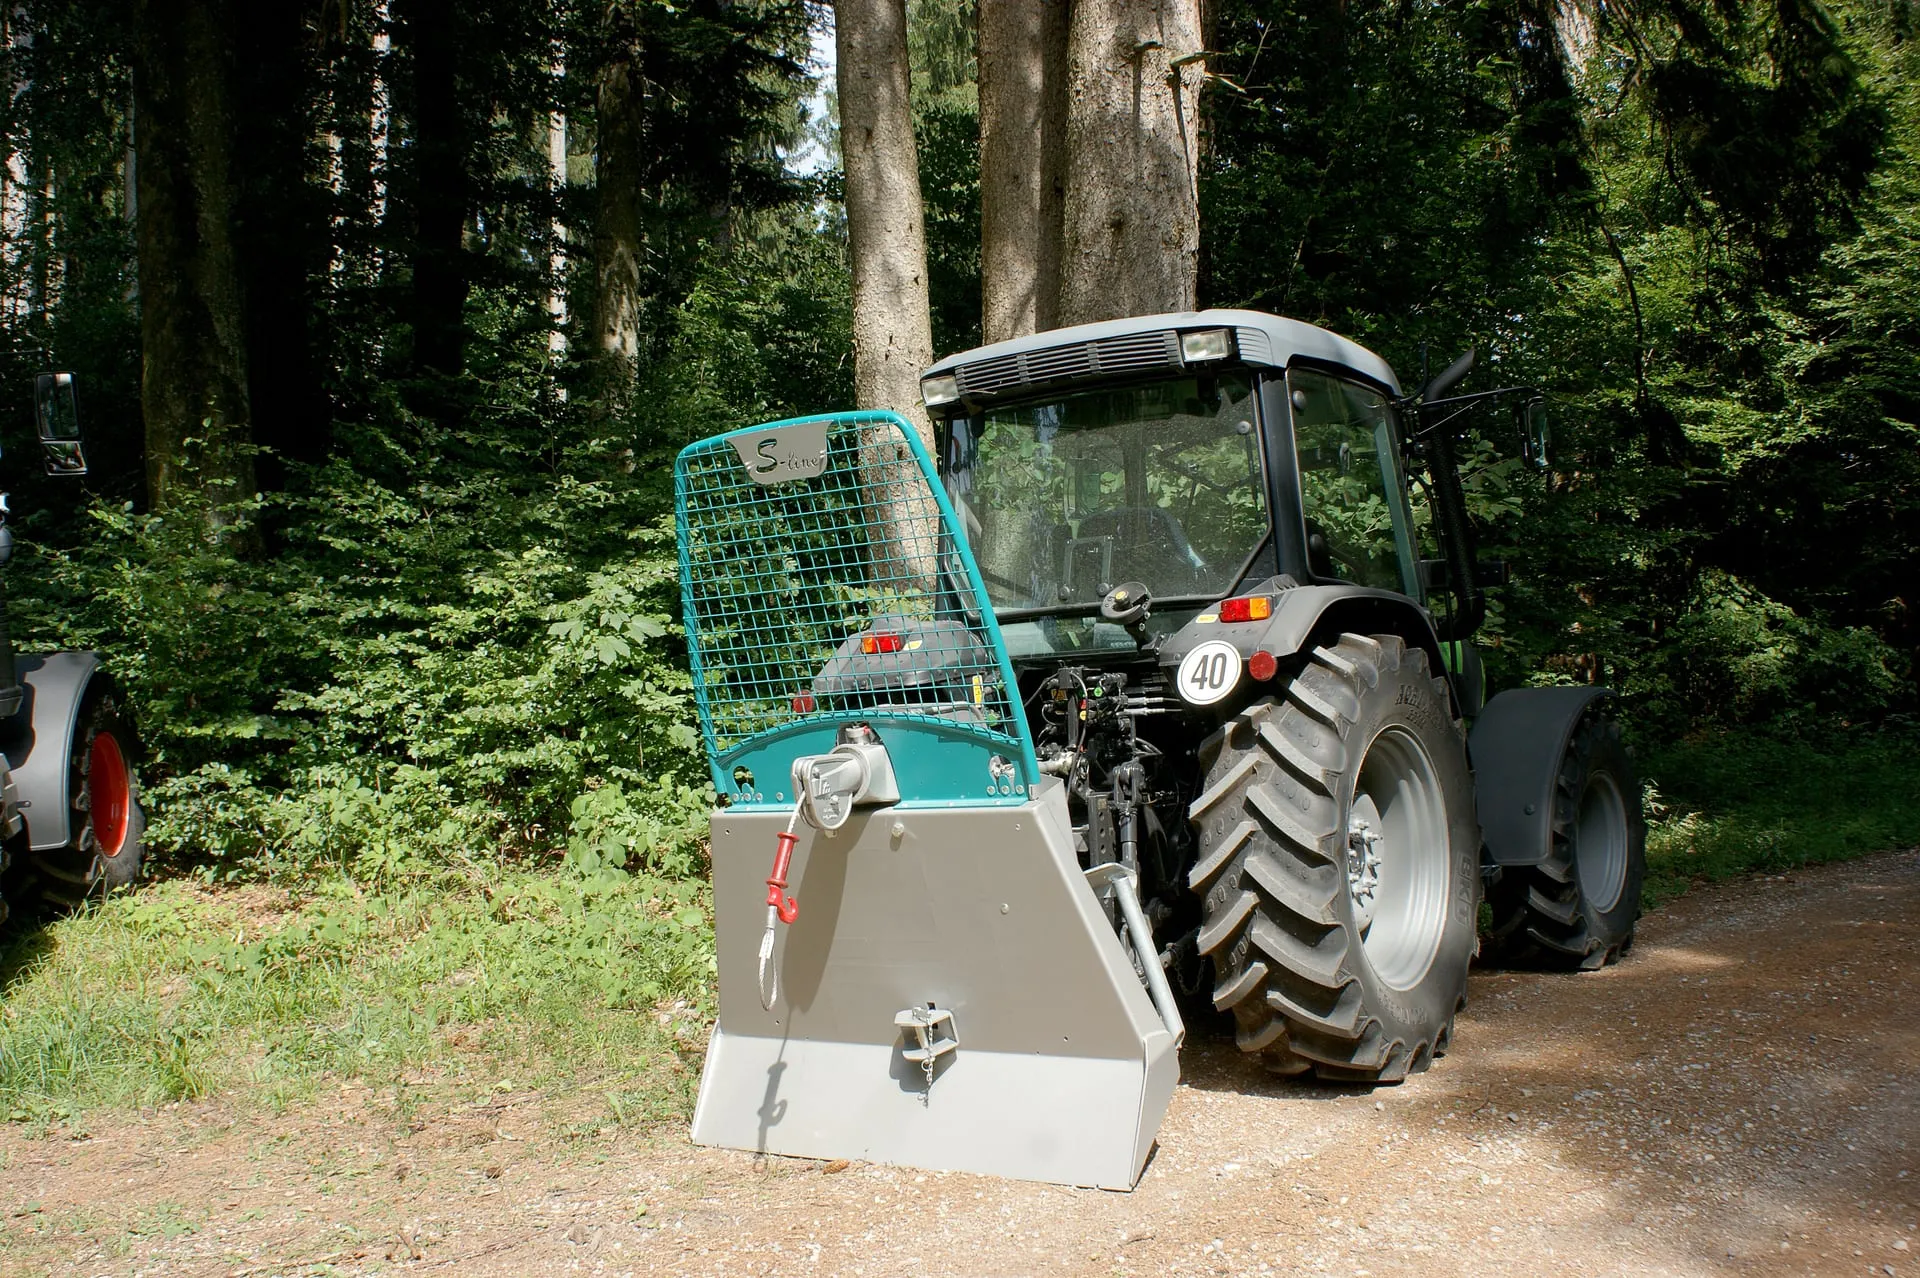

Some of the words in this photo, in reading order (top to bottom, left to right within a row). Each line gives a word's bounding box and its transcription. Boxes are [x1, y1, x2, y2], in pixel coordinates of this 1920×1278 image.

[755, 438, 819, 474] S-line
[1191, 653, 1227, 690] 40
[1455, 855, 1472, 926] BKT
